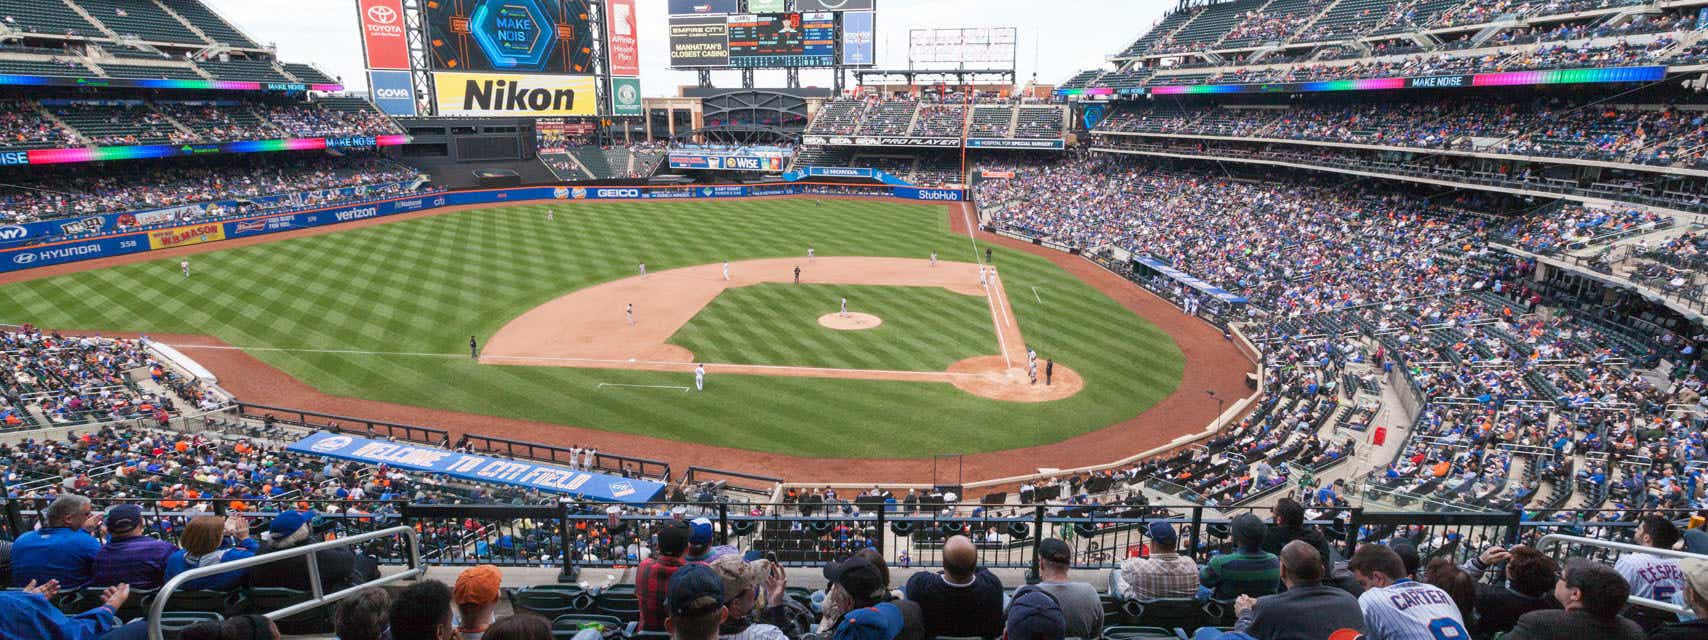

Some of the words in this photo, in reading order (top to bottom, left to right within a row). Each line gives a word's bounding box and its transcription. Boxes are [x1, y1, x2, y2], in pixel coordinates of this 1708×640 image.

[367, 24, 402, 33] TOYOTA
[496, 17, 531, 30] MAKE
[675, 43, 722, 51] MANHATTAN'S
[671, 50, 701, 58] CLOSEST
[1412, 77, 1437, 87] MAKE
[1437, 76, 1463, 87] NOISE
[268, 83, 287, 91] MAKE
[287, 83, 306, 91] NOISE
[464, 79, 575, 111] Nikon
[326, 137, 352, 147] MAKE
[881, 137, 907, 145] PRO
[907, 138, 958, 146] PLAYER
[737, 158, 759, 168] WISE
[598, 189, 639, 198] GEICO
[918, 189, 958, 201] StubHub
[335, 206, 377, 222] verizon
[120, 240, 137, 249] 358
[40, 244, 102, 261] HYUNDAI
[352, 441, 450, 467] WELCOME
[446, 455, 485, 472] TO
[477, 460, 532, 480] CITI
[520, 466, 592, 490] FIELD
[1390, 590, 1451, 611] CARTER
